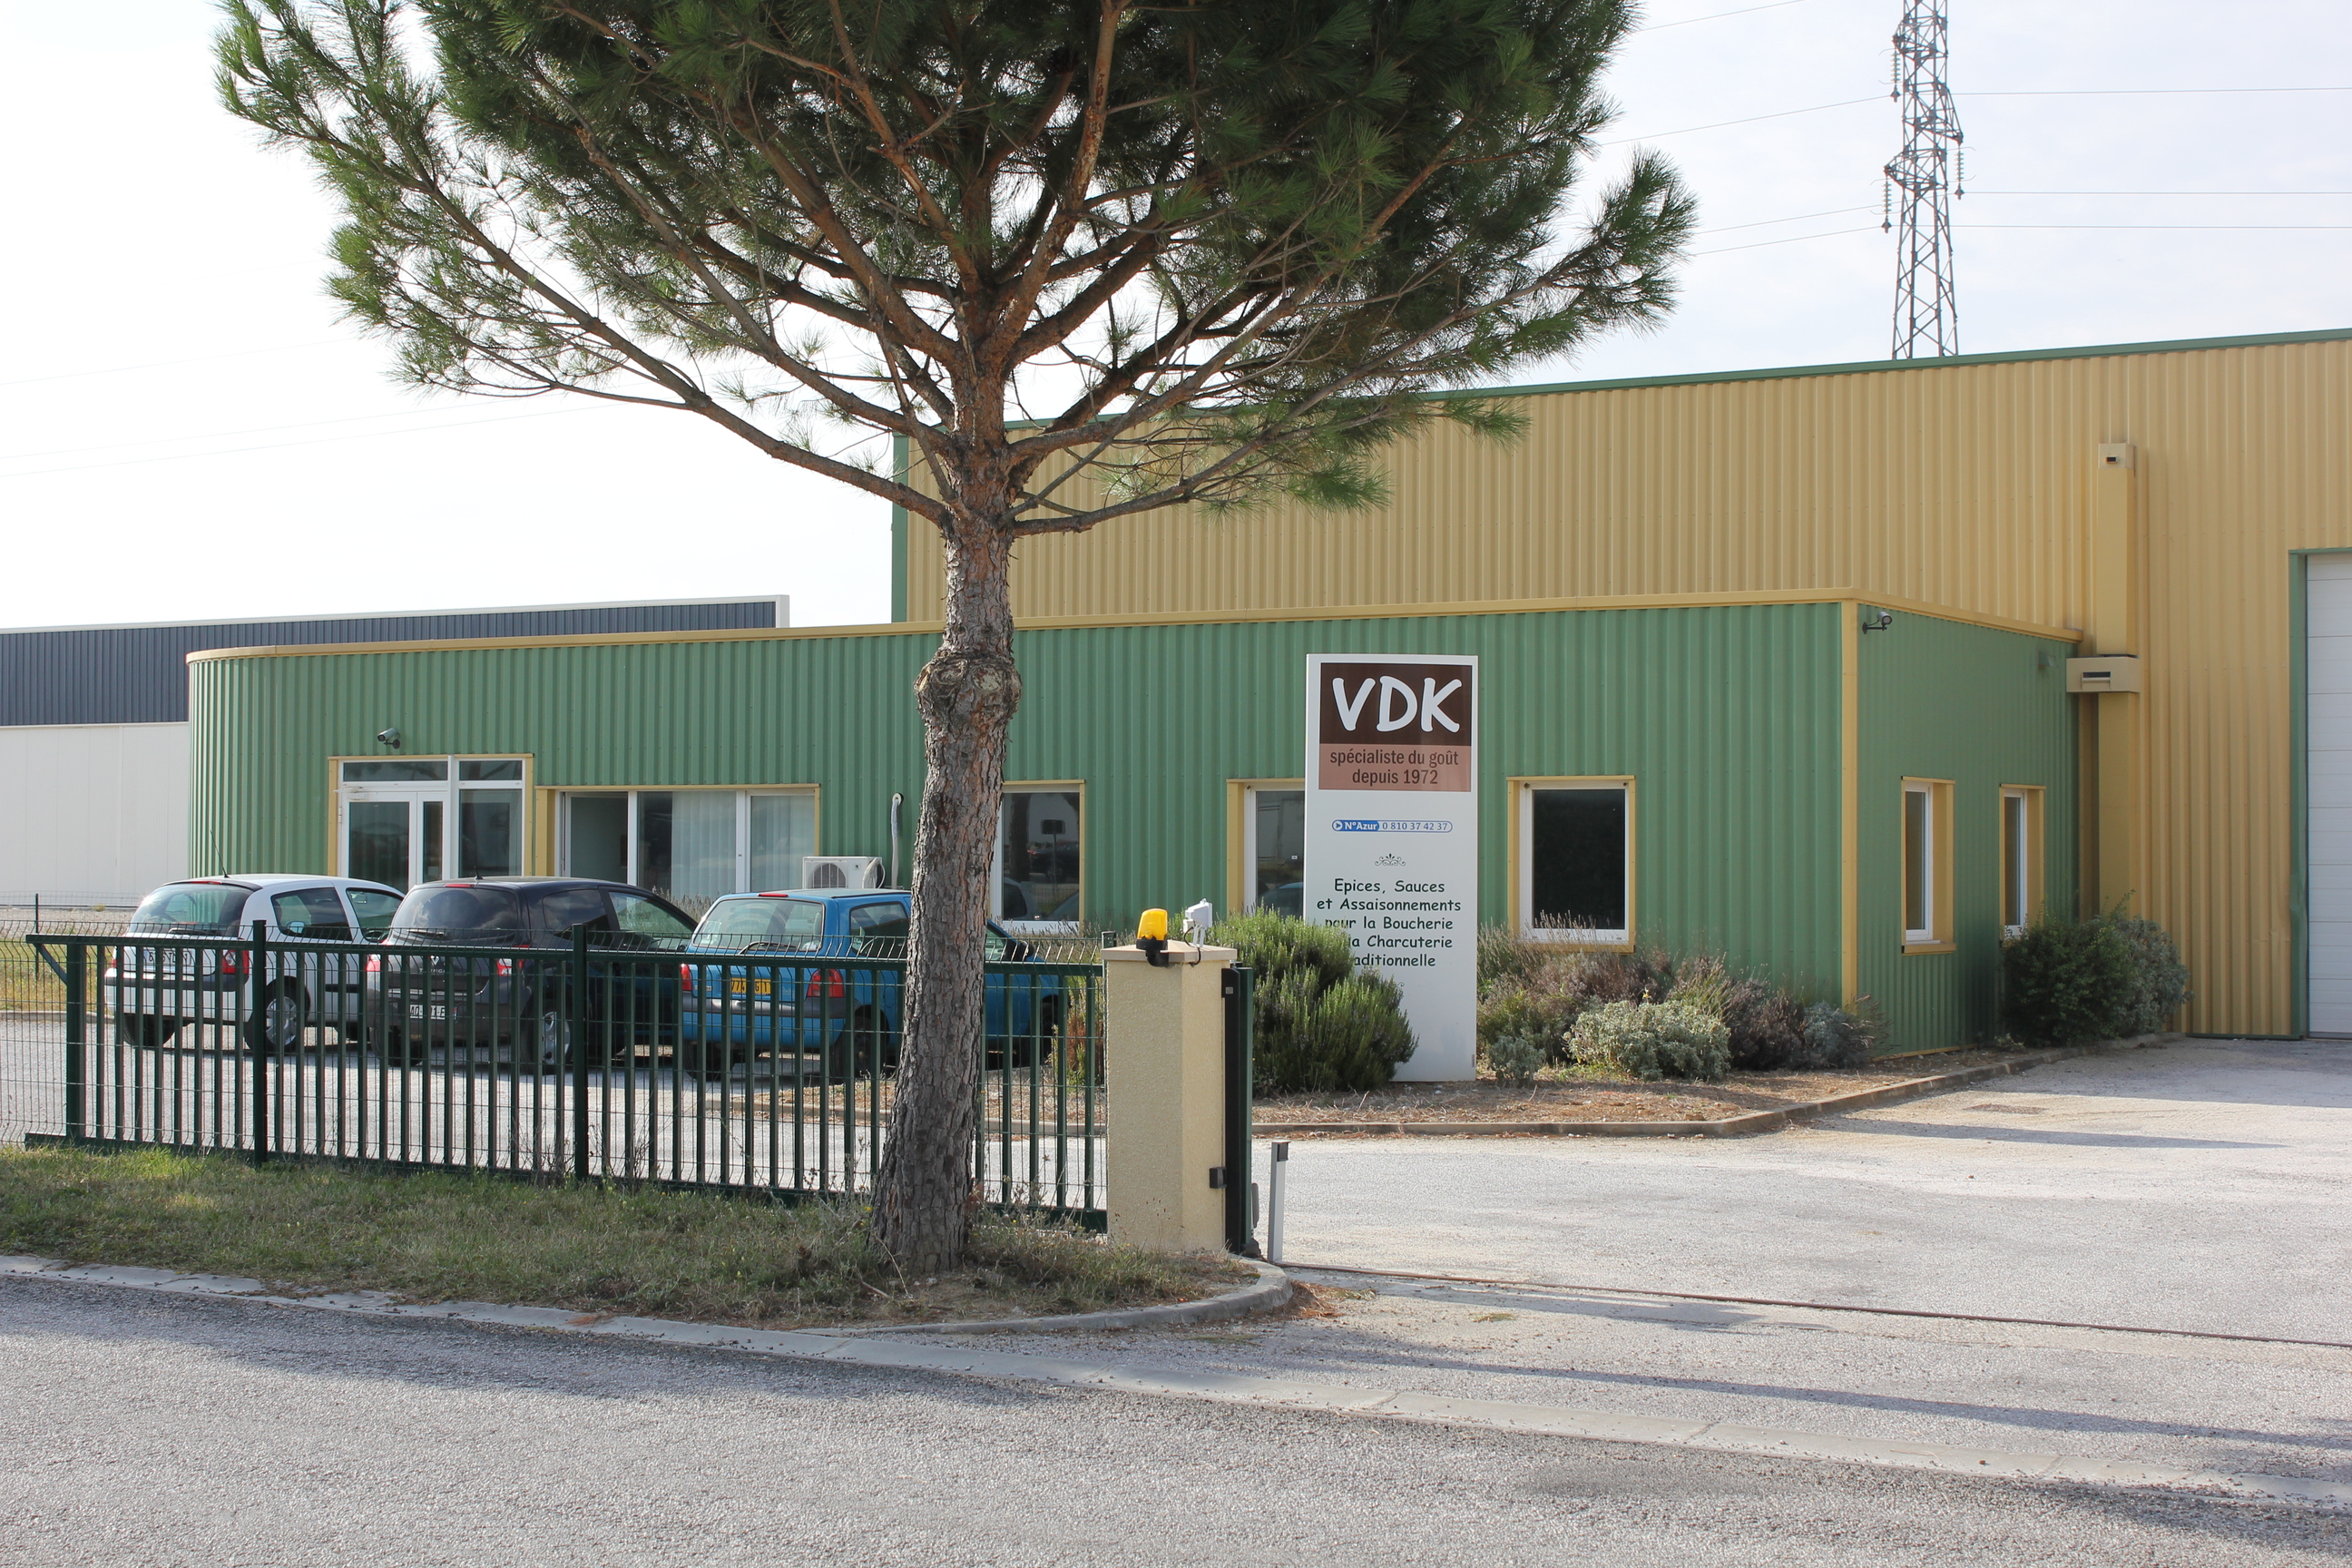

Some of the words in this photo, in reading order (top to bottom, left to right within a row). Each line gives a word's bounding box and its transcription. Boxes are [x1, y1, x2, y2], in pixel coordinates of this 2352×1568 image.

[1331, 675, 1463, 733] VDK
[1330, 749, 1405, 767] spécialiste
[1408, 750, 1425, 764] du
[1429, 750, 1459, 768] goût
[1352, 769, 1398, 787] depuis
[1403, 769, 1438, 784] 1972
[1390, 822, 1407, 830] 810
[1410, 822, 1421, 830] 37
[1423, 822, 1434, 830] 42
[1334, 878, 1386, 895] Epices,
[1394, 880, 1446, 893] Sauces
[1317, 898, 1333, 909] et
[1339, 898, 1461, 911] Assaisonnements
[1364, 916, 1376, 929] la
[1383, 916, 1454, 930] Boucherie
[1367, 935, 1453, 948] Charcuterie
[1354, 953, 1436, 966] aditionnelle
